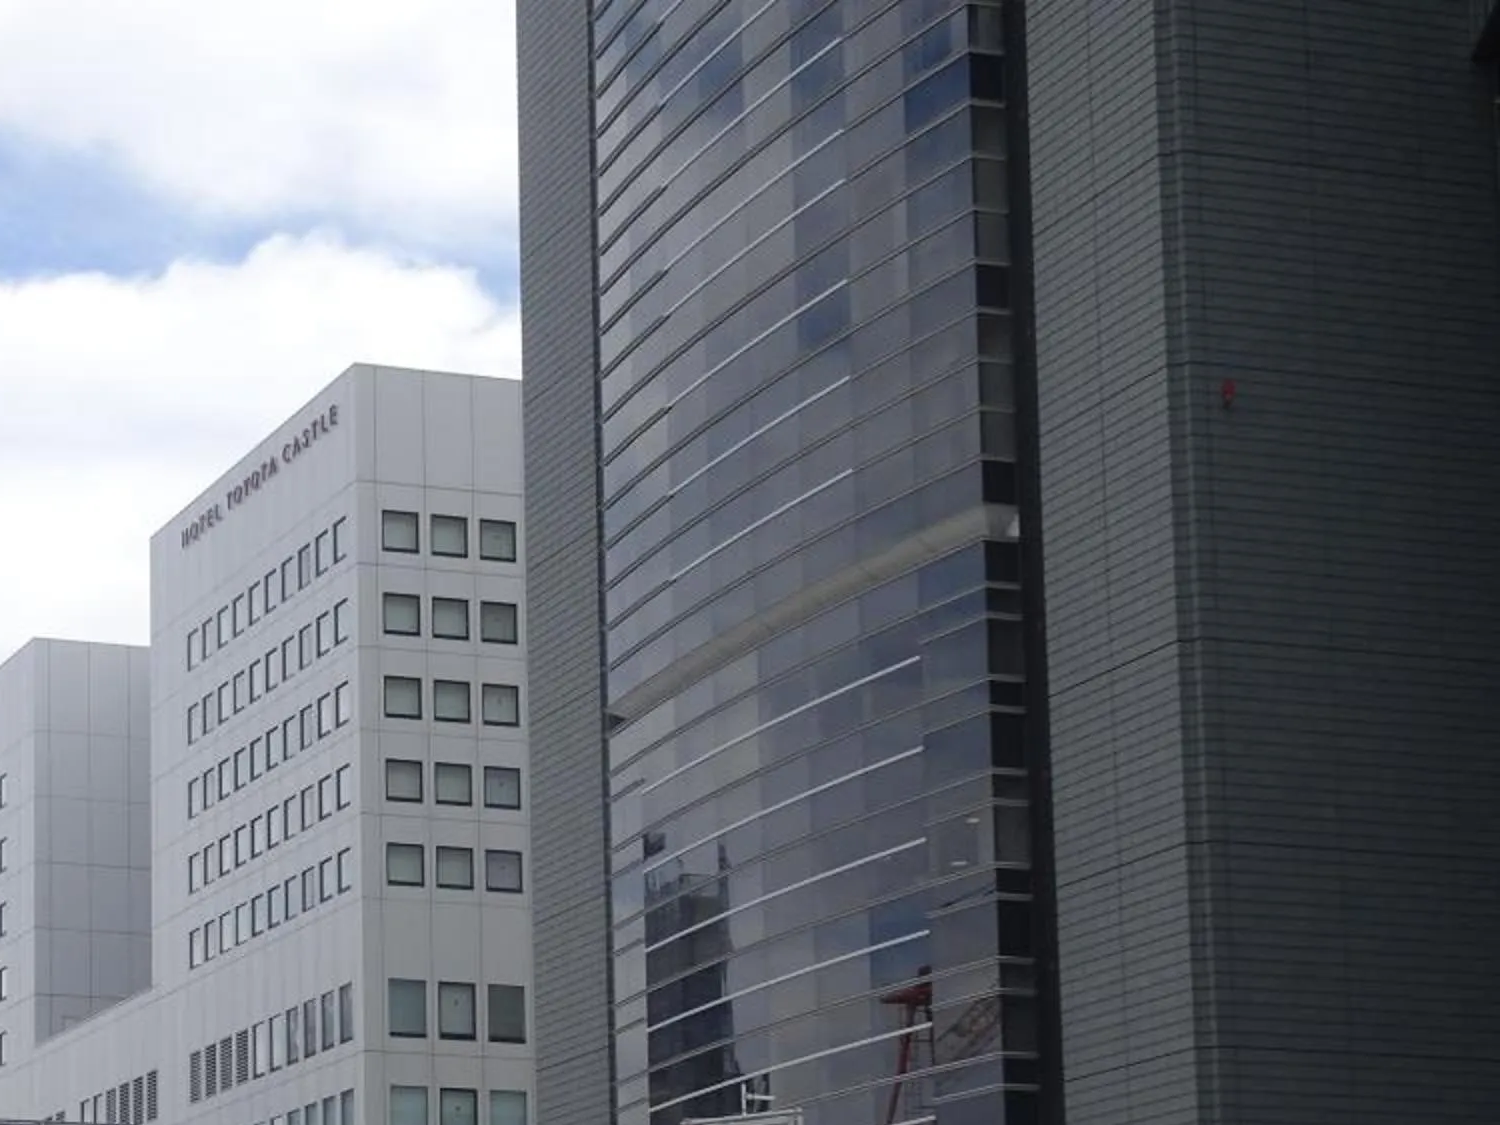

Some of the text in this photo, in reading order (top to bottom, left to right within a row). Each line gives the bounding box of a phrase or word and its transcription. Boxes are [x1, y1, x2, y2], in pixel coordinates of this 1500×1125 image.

[181, 404, 339, 549] HOTEL TOYOTA CASTLE
